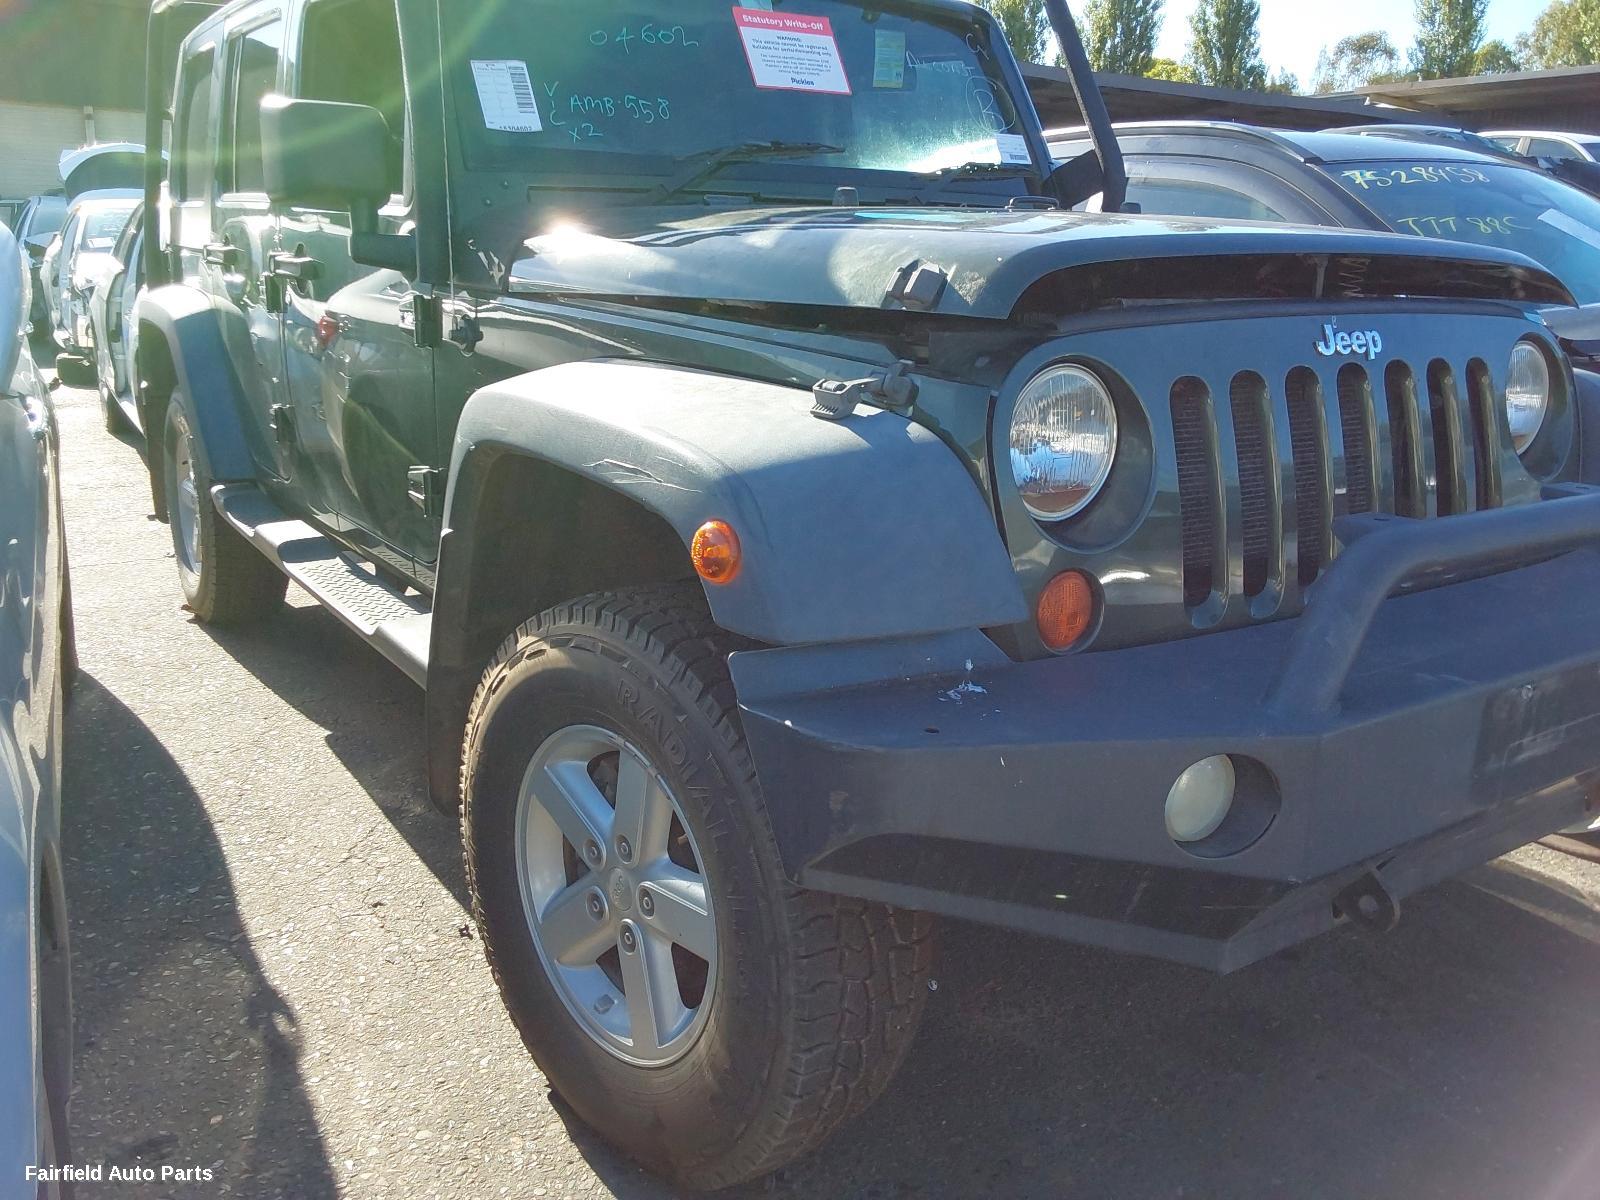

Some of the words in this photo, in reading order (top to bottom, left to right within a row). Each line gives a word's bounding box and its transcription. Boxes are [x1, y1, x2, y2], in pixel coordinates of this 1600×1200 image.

[742, 14, 782, 27] Statutory
[784, 19, 824, 31] Write-Off
[790, 76, 815, 86] Pickles
[1397, 216, 1457, 237] TTT
[1316, 324, 1382, 360] Jeep
[616, 679, 729, 848] RADIAL
